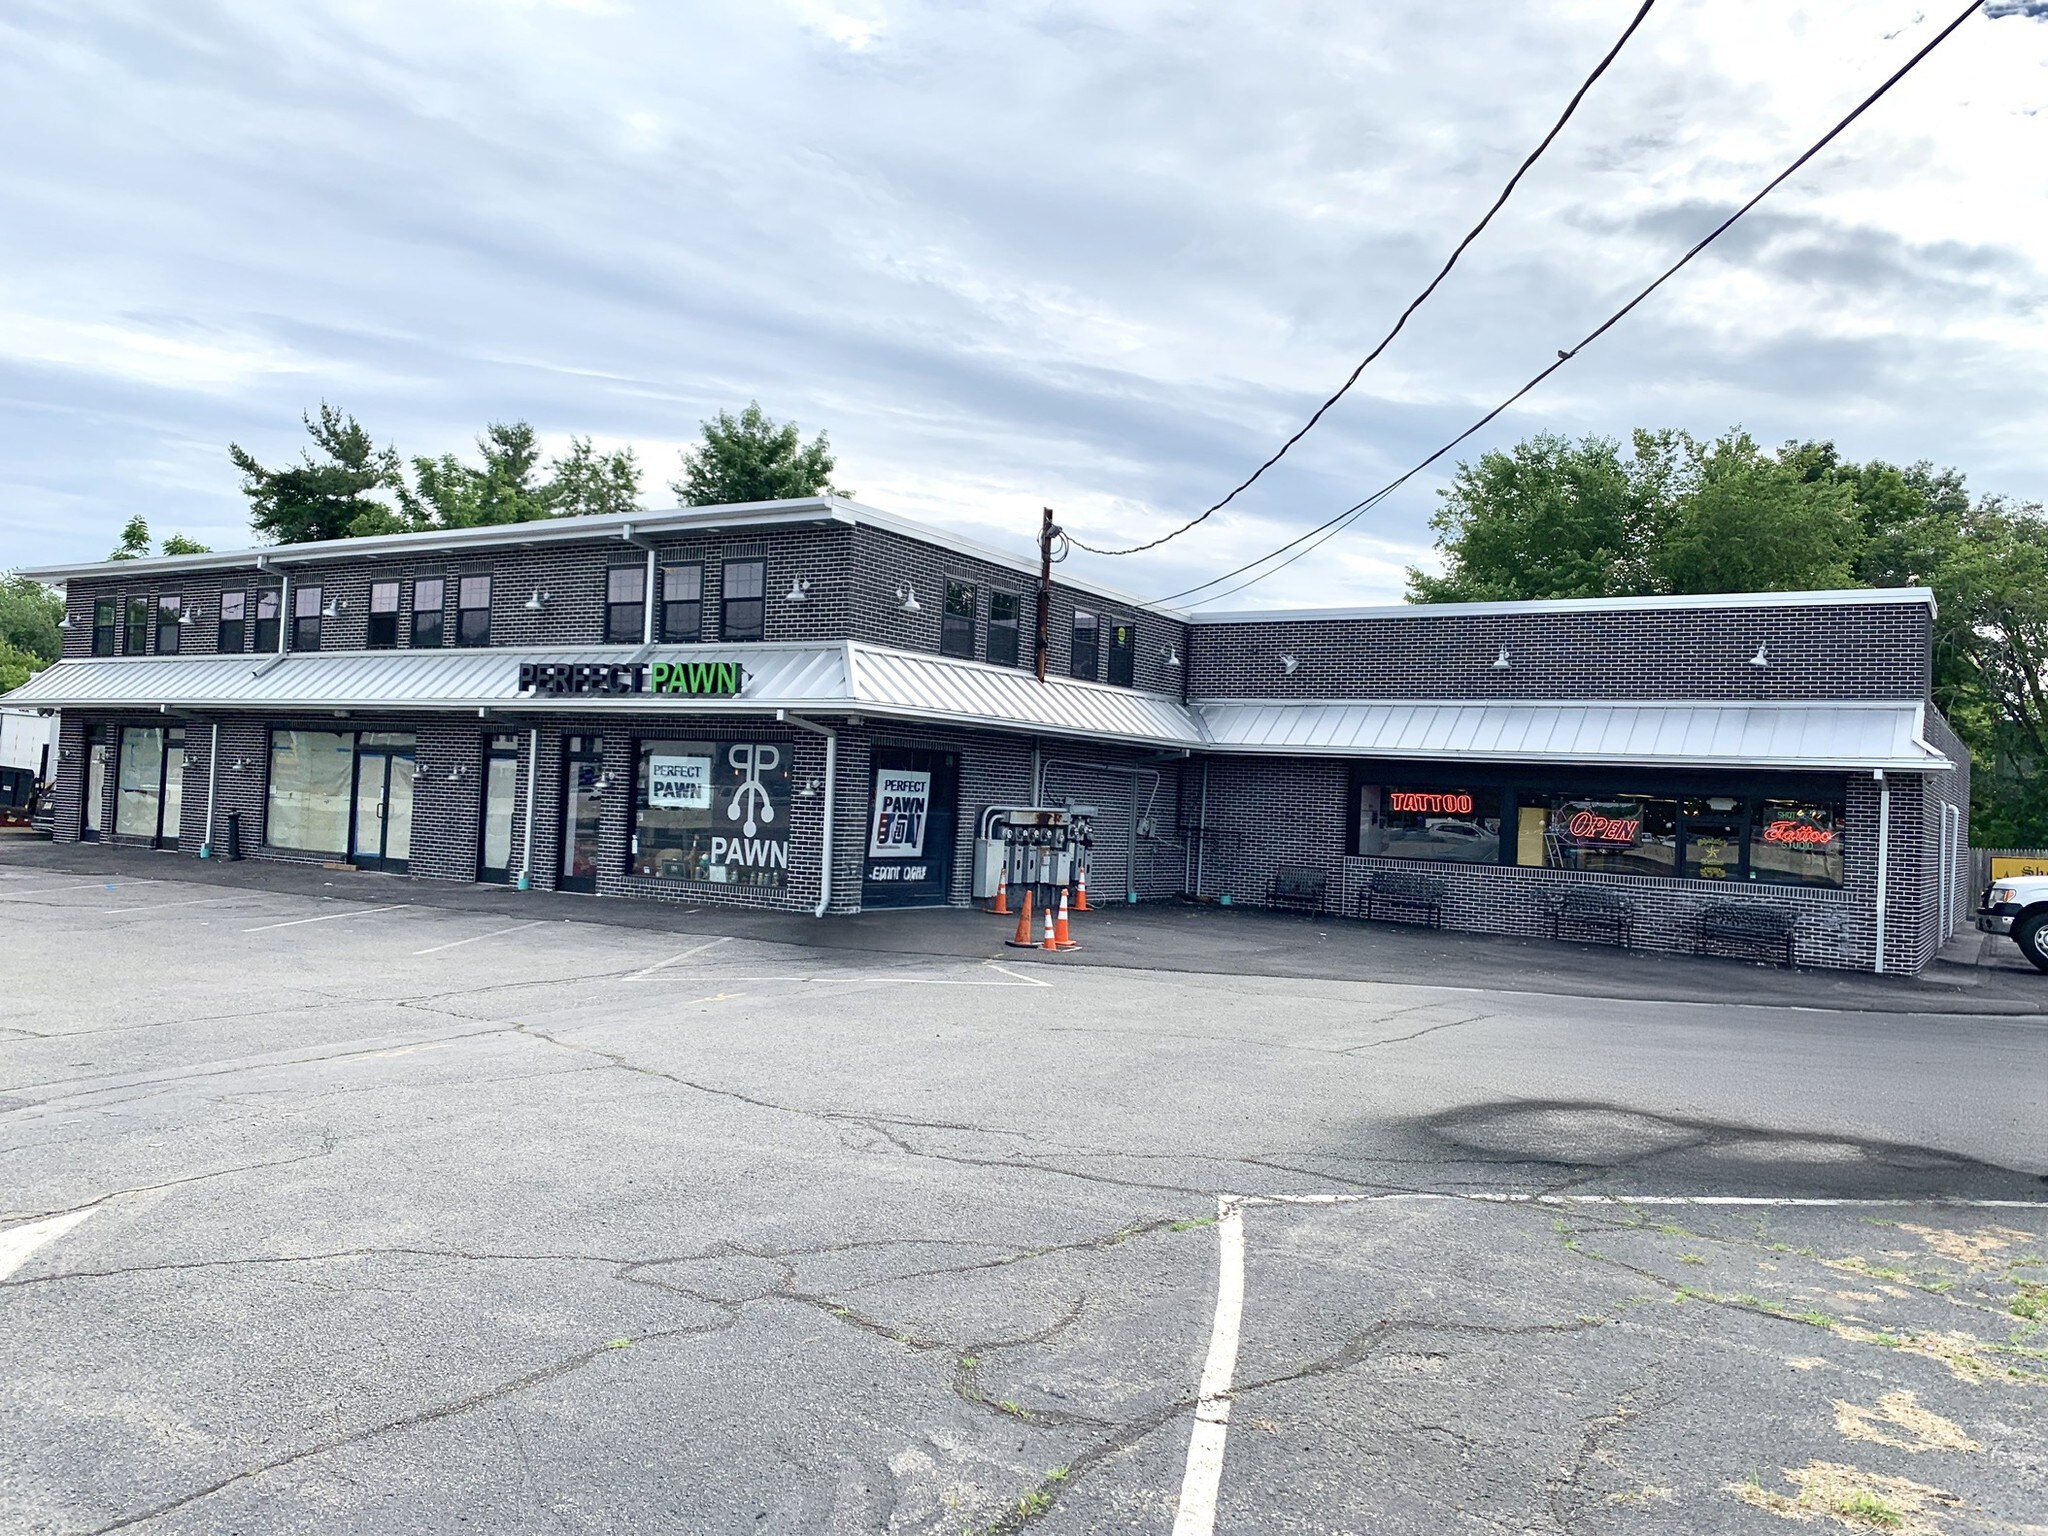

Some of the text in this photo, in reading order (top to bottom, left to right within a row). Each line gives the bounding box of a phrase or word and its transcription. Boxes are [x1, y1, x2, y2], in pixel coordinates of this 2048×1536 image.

[518, 662, 742, 693] PERFECT PAWN
[653, 764, 702, 778] PERFECT
[653, 781, 702, 799] PAWN
[884, 779, 927, 793] PERFECT
[882, 796, 926, 813] PAWN
[1390, 793, 1472, 813] TATTOO
[1764, 820, 1832, 843] Tattoo
[711, 836, 789, 869] PAWN
[1781, 841, 1814, 850] STUDIO
